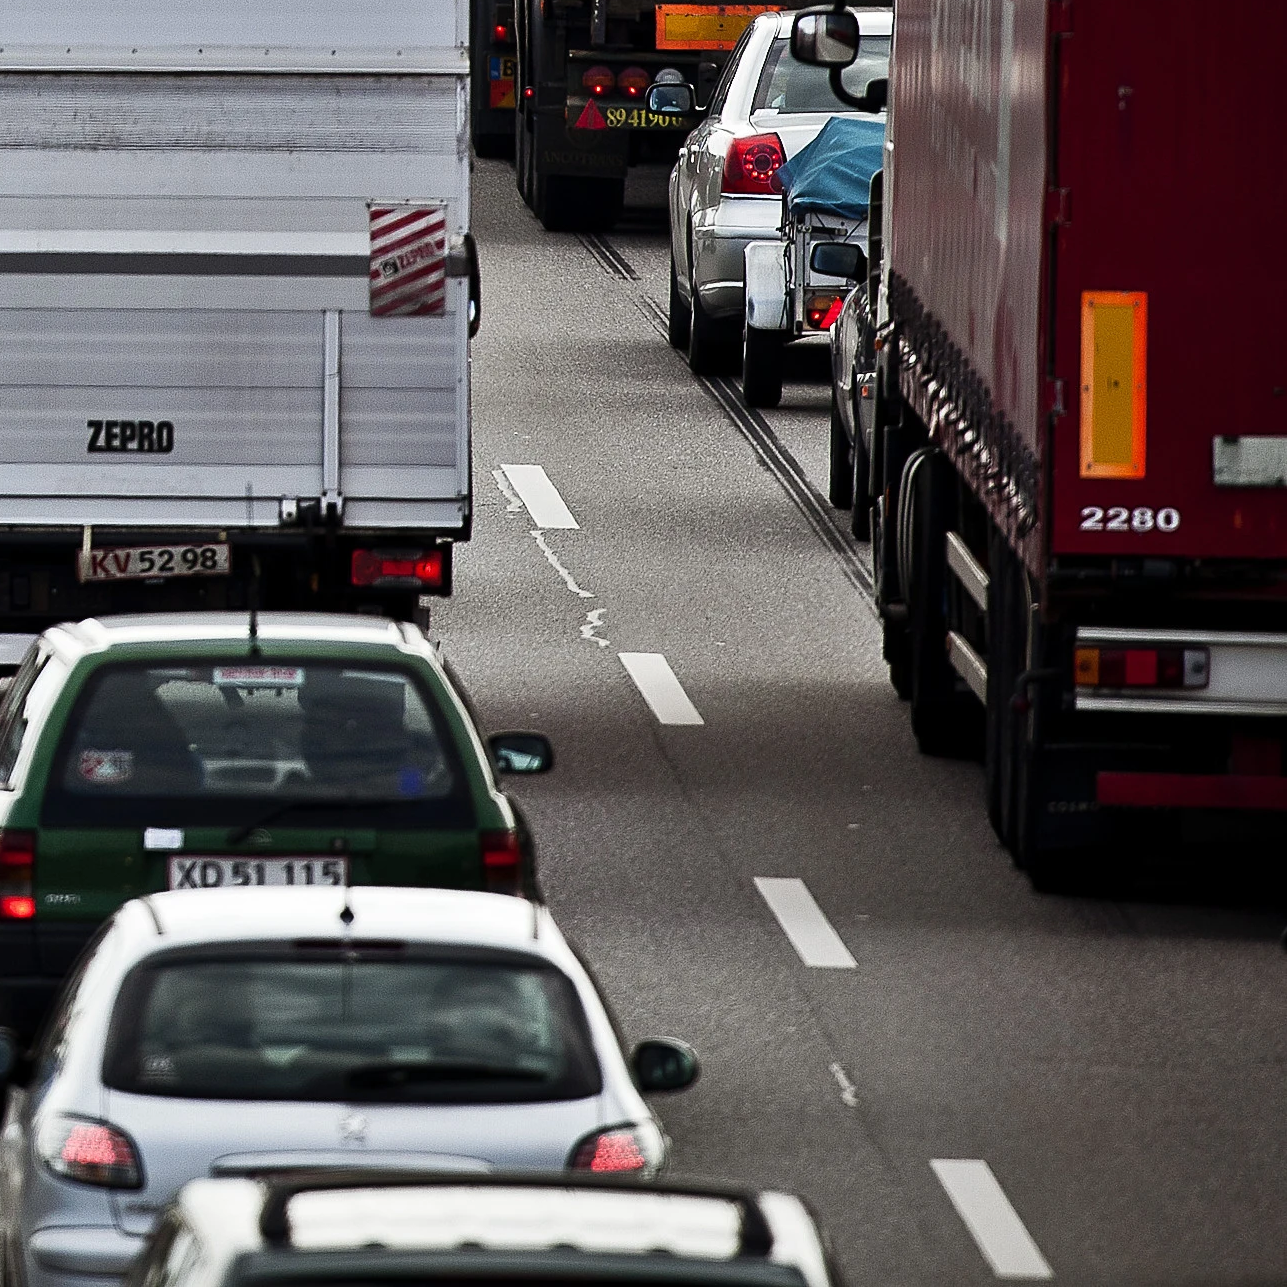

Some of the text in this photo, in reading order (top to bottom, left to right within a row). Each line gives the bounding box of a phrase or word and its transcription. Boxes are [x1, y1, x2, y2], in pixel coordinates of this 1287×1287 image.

[86, 419, 175, 454] ZEPRO
[1079, 506, 1181, 532] 2280
[91, 547, 218, 576] KV 52 98
[176, 861, 342, 889] XD 51 115
